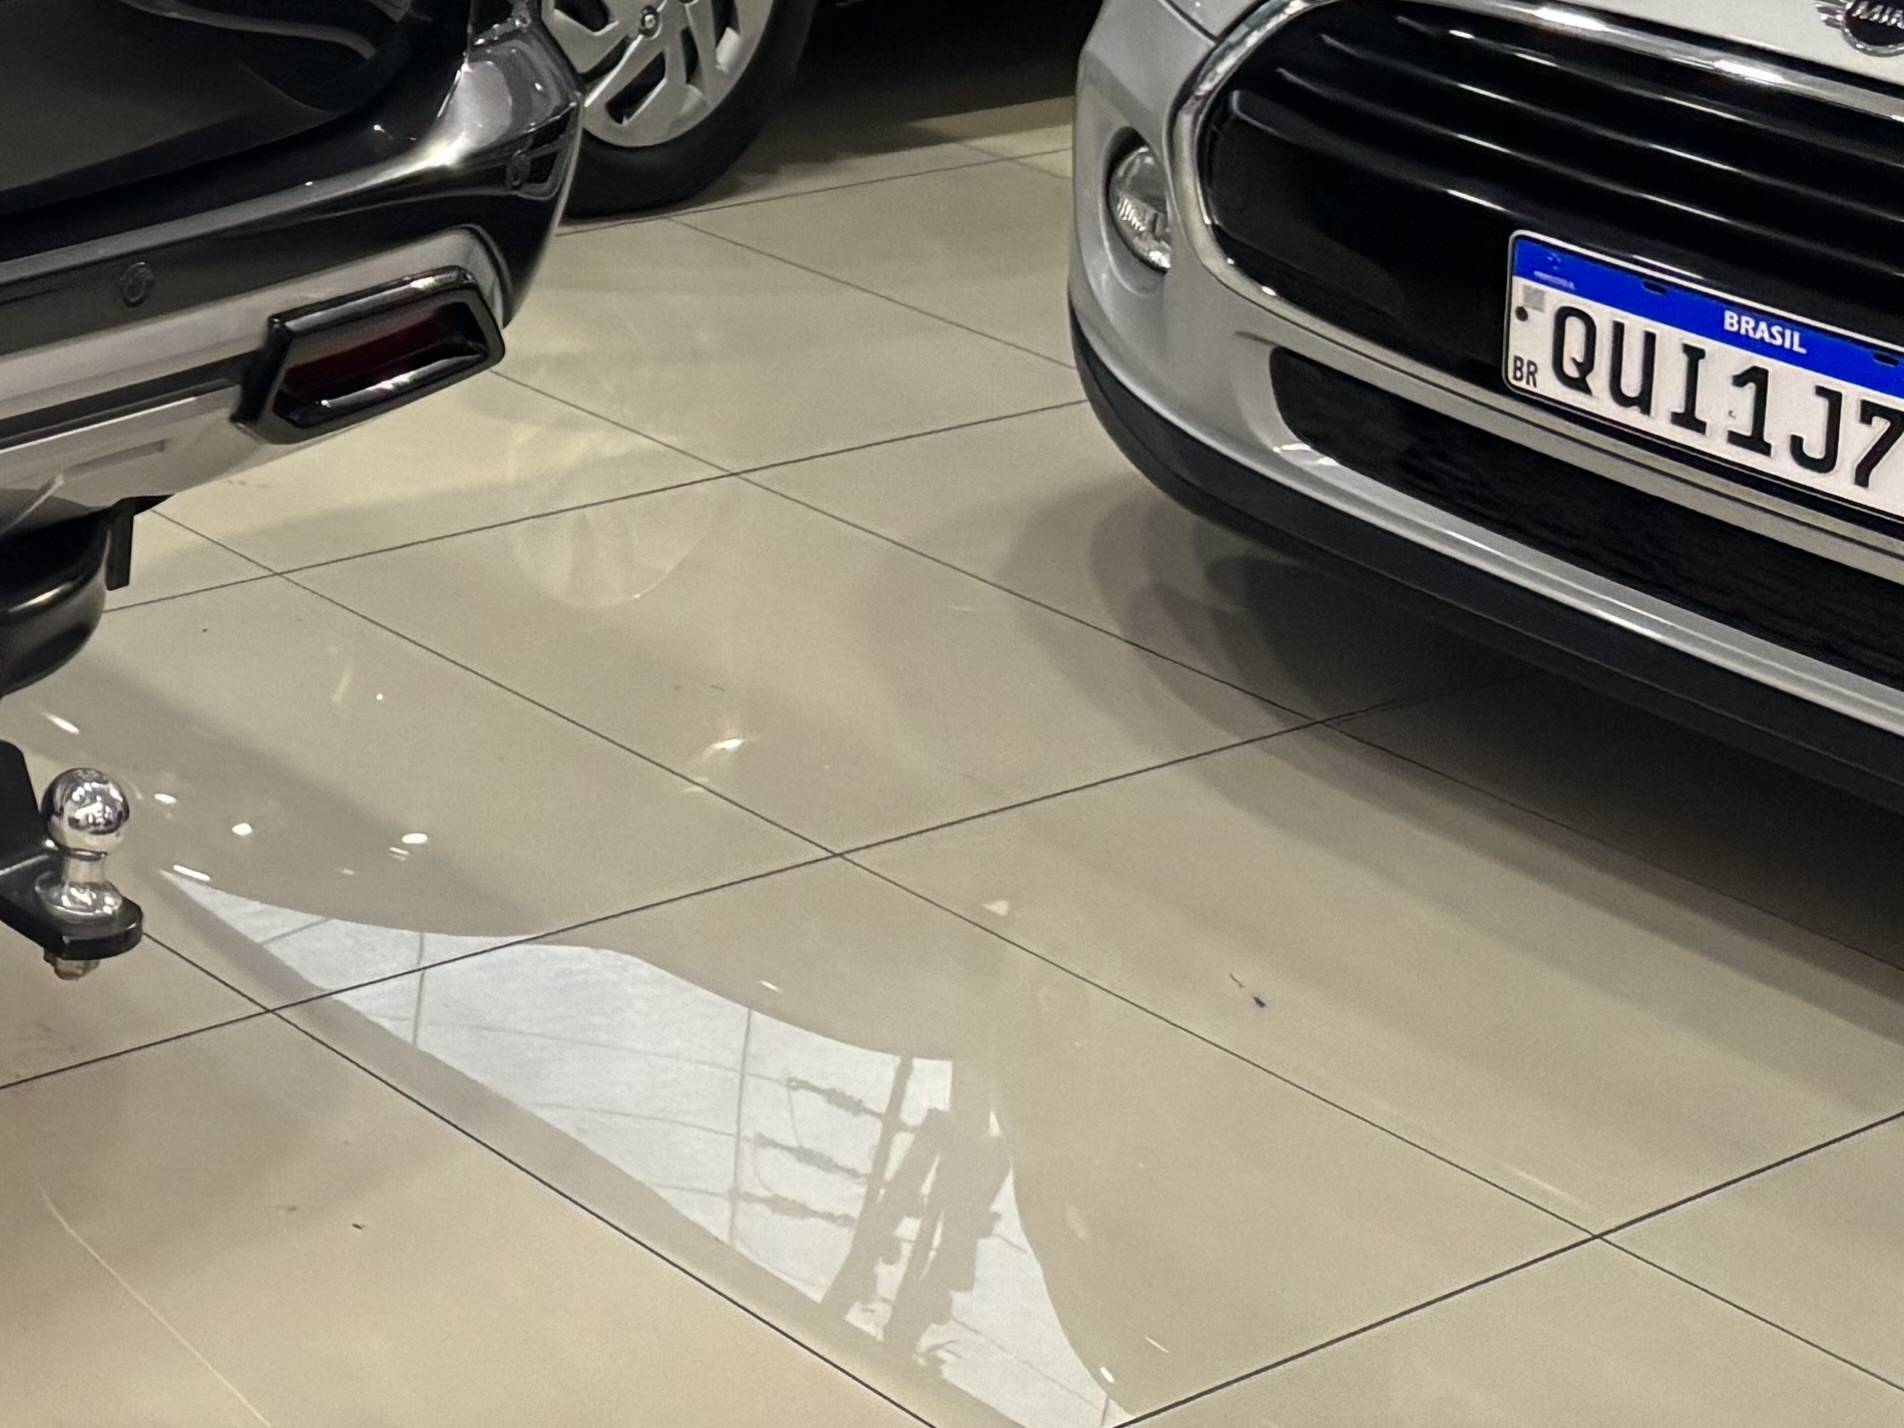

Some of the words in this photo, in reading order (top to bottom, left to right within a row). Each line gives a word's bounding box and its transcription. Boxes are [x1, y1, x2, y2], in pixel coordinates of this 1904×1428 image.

[1723, 310, 1807, 355] BRASIL
[1511, 354, 1539, 389] BR
[1551, 304, 1904, 490] QUI1J7
